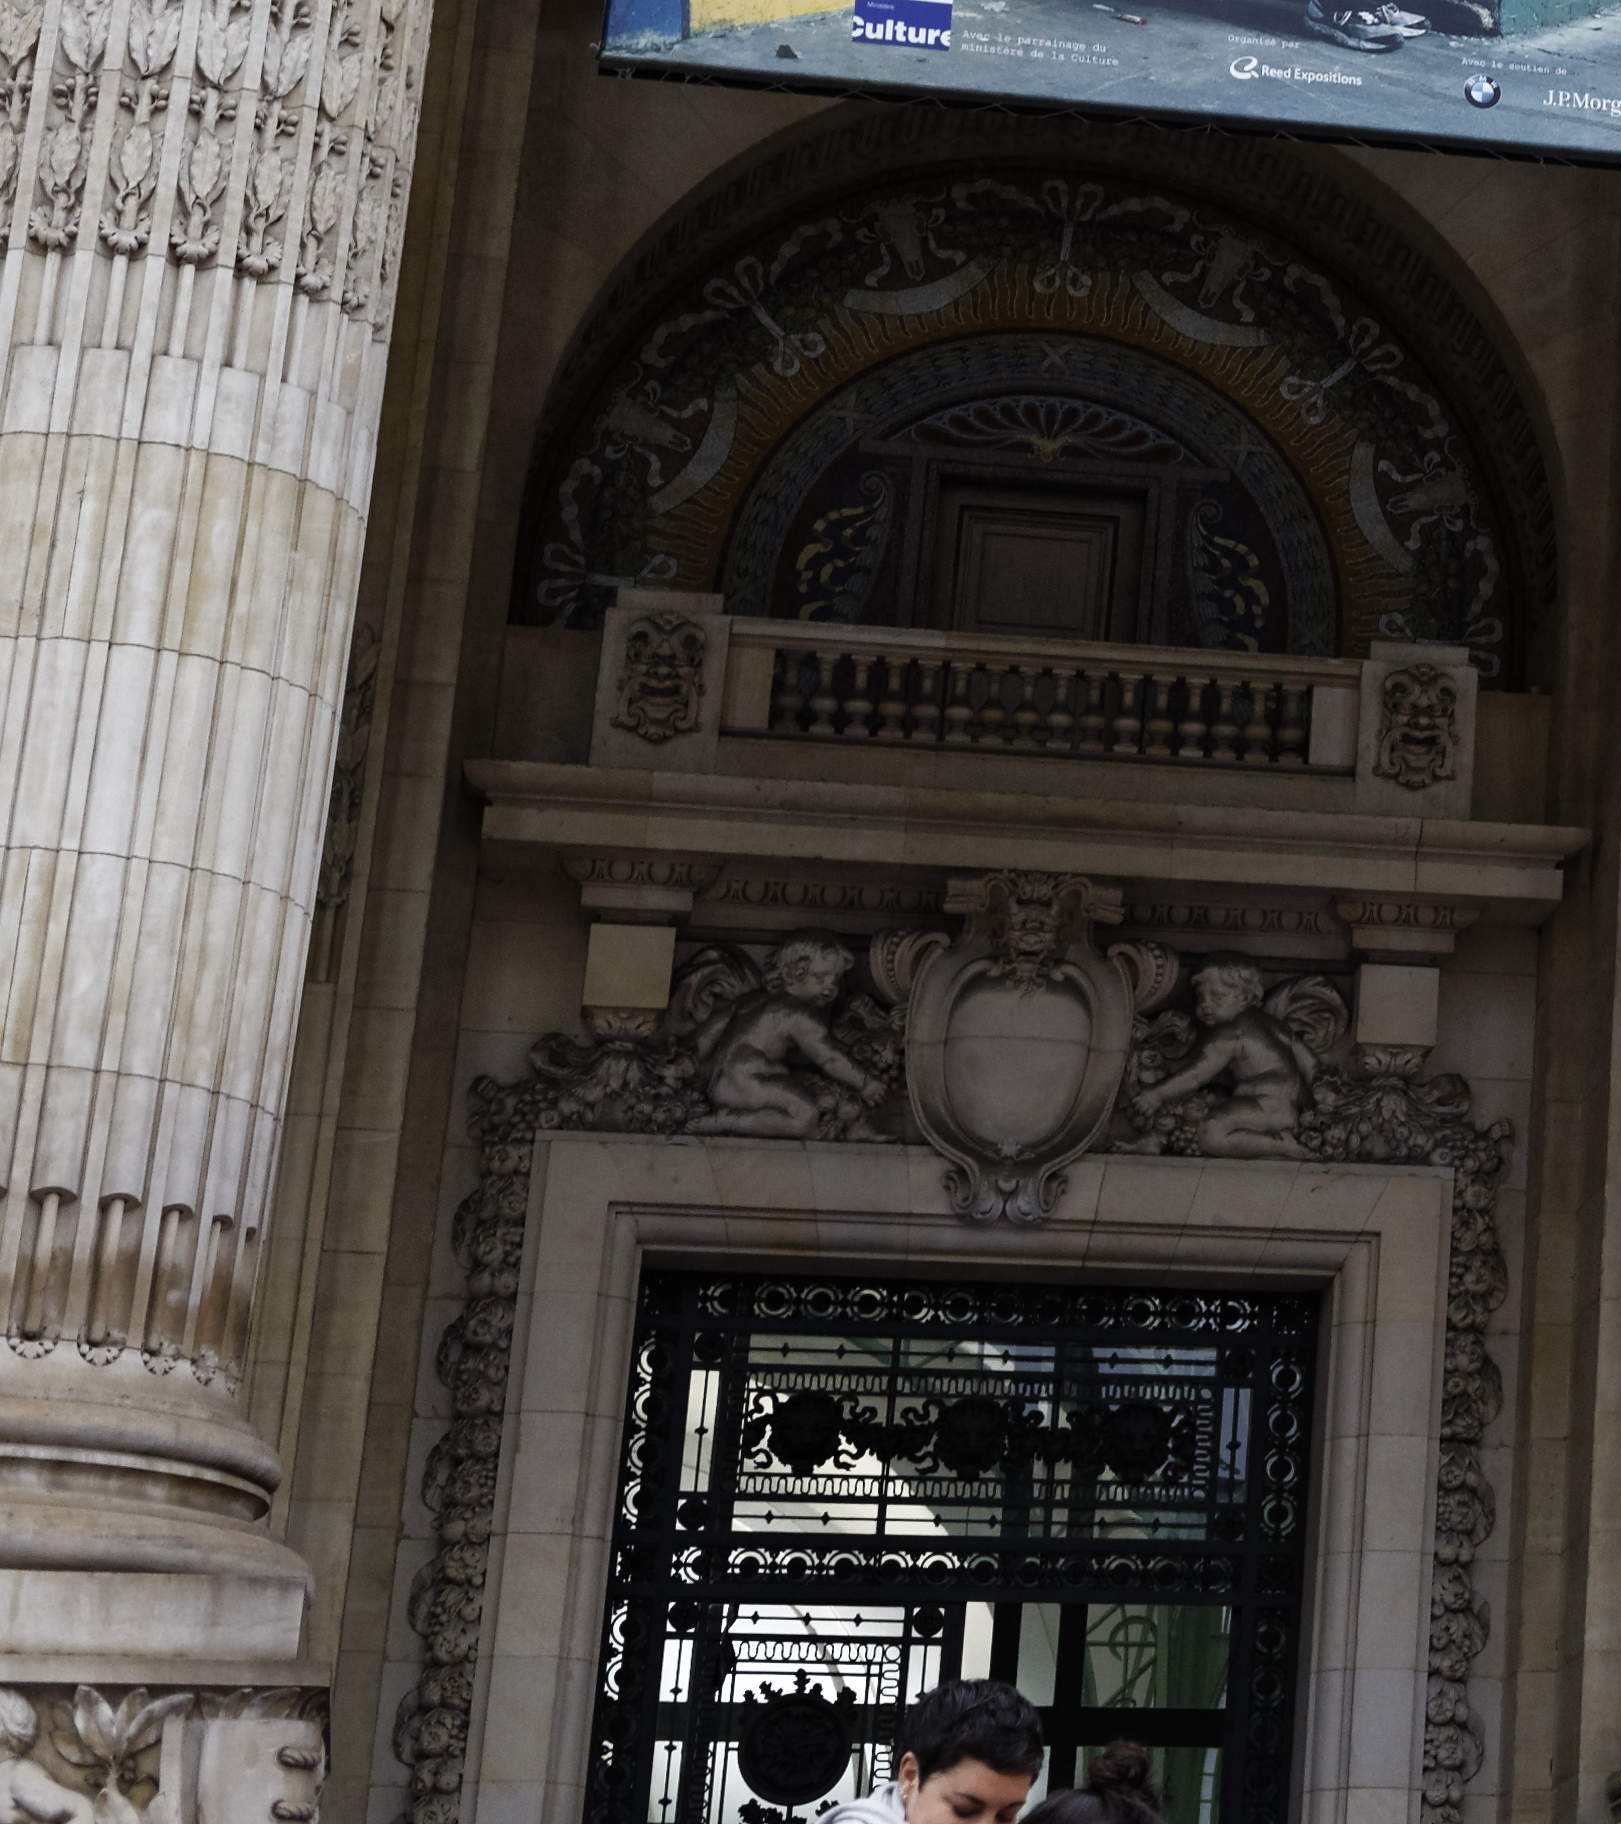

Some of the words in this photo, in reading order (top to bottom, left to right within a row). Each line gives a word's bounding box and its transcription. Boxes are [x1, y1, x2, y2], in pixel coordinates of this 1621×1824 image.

[961, 30, 991, 42] Avec
[998, 33, 1011, 43] le
[1017, 35, 1087, 52] parrainage
[1092, 42, 1107, 53] du
[1281, 40, 1300, 49] par
[961, 43, 1024, 57] ministère
[1030, 48, 1044, 58] de
[1052, 52, 1065, 61] la
[1071, 54, 1120, 66] Culture
[1261, 64, 1291, 80] Reed
[1294, 67, 1363, 86] Expositions
[1461, 56, 1486, 68] Avec
[1492, 59, 1503, 69] le
[1509, 62, 1550, 74] soutien
[1555, 66, 1568, 76] de
